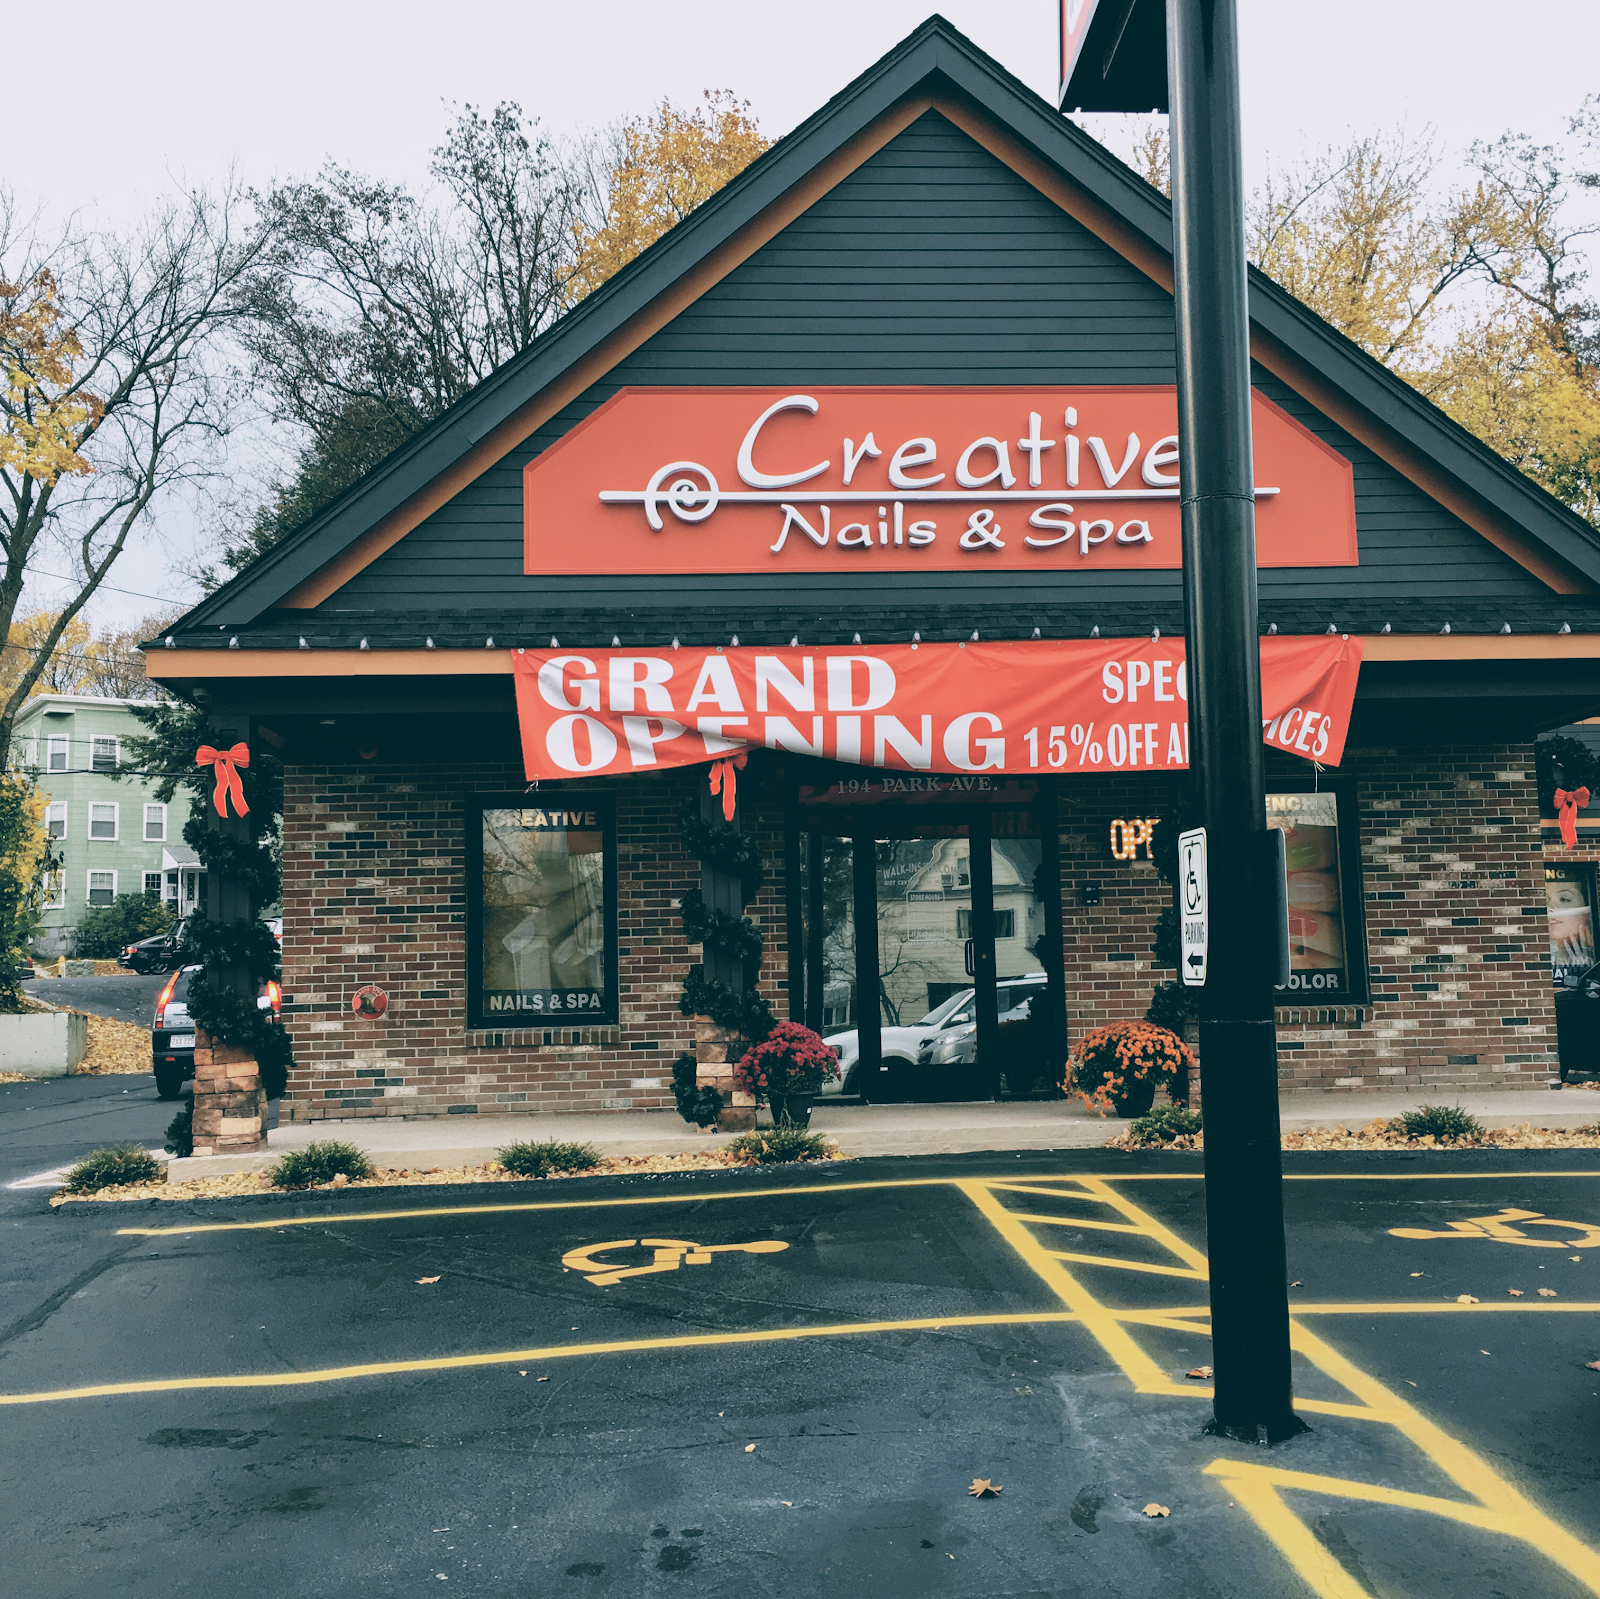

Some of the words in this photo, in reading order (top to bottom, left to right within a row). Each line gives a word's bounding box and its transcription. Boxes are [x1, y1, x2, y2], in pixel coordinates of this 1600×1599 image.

[737, 394, 1179, 488] Creative
[770, 501, 936, 553] Nails
[959, 509, 1005, 550] &
[1024, 502, 1153, 556] Spa
[537, 655, 897, 713] GRAND
[545, 712, 1005, 772] OPENING
[1262, 707, 1331, 756] ICES
[837, 779, 871, 794] 194
[881, 777, 942, 793] PARK
[949, 776, 998, 791] AVE.
[1185, 922, 1205, 944] PARKING
[490, 994, 544, 1010] NAILS
[549, 994, 563, 1009] &
[566, 993, 601, 1008] SPA
